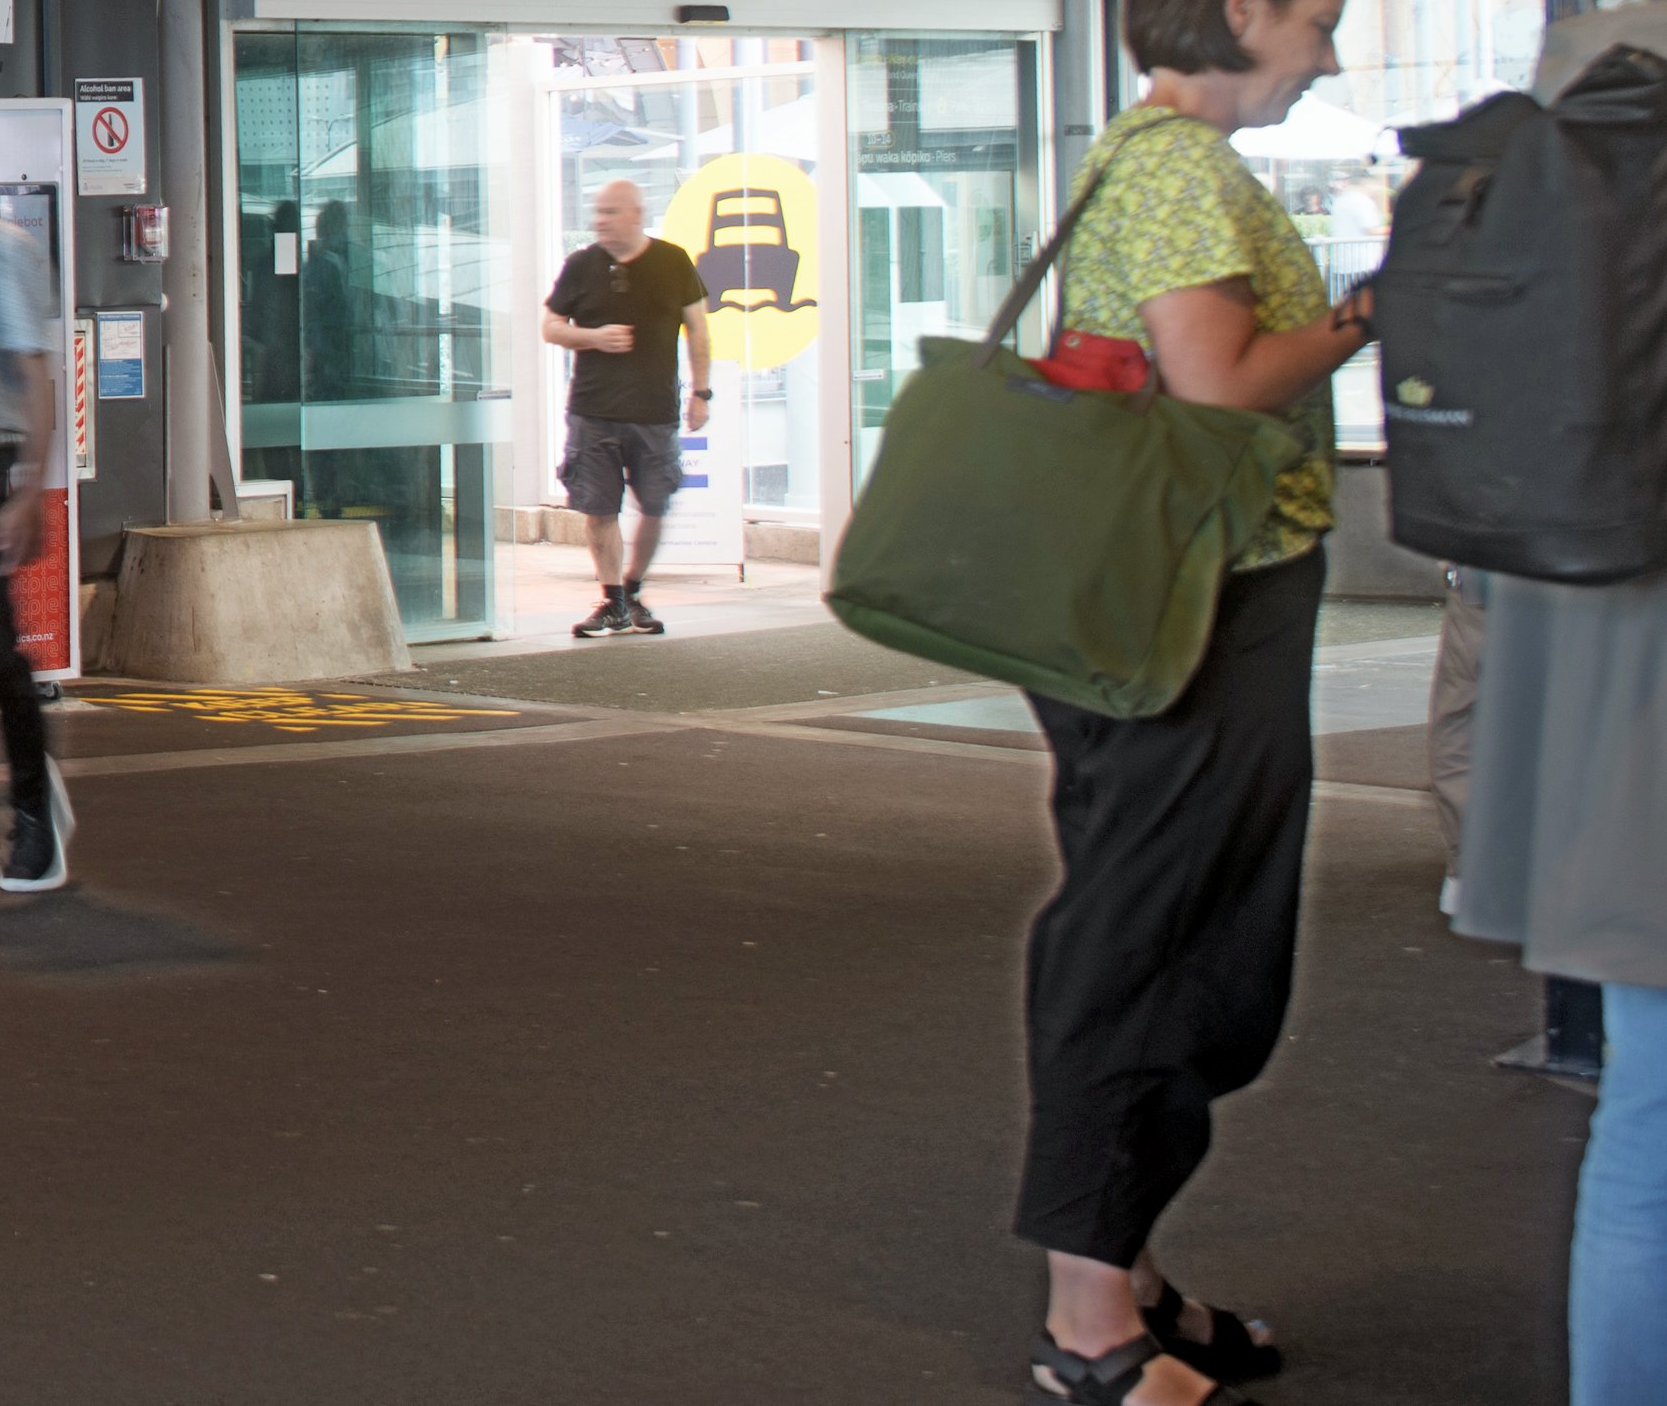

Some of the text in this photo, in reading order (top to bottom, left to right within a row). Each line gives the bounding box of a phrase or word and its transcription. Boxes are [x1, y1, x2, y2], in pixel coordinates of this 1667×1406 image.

[80, 85, 104, 93] Alcohol
[104, 84, 117, 93] ban
[875, 152, 900, 163] waka
[935, 150, 957, 163] Piers
